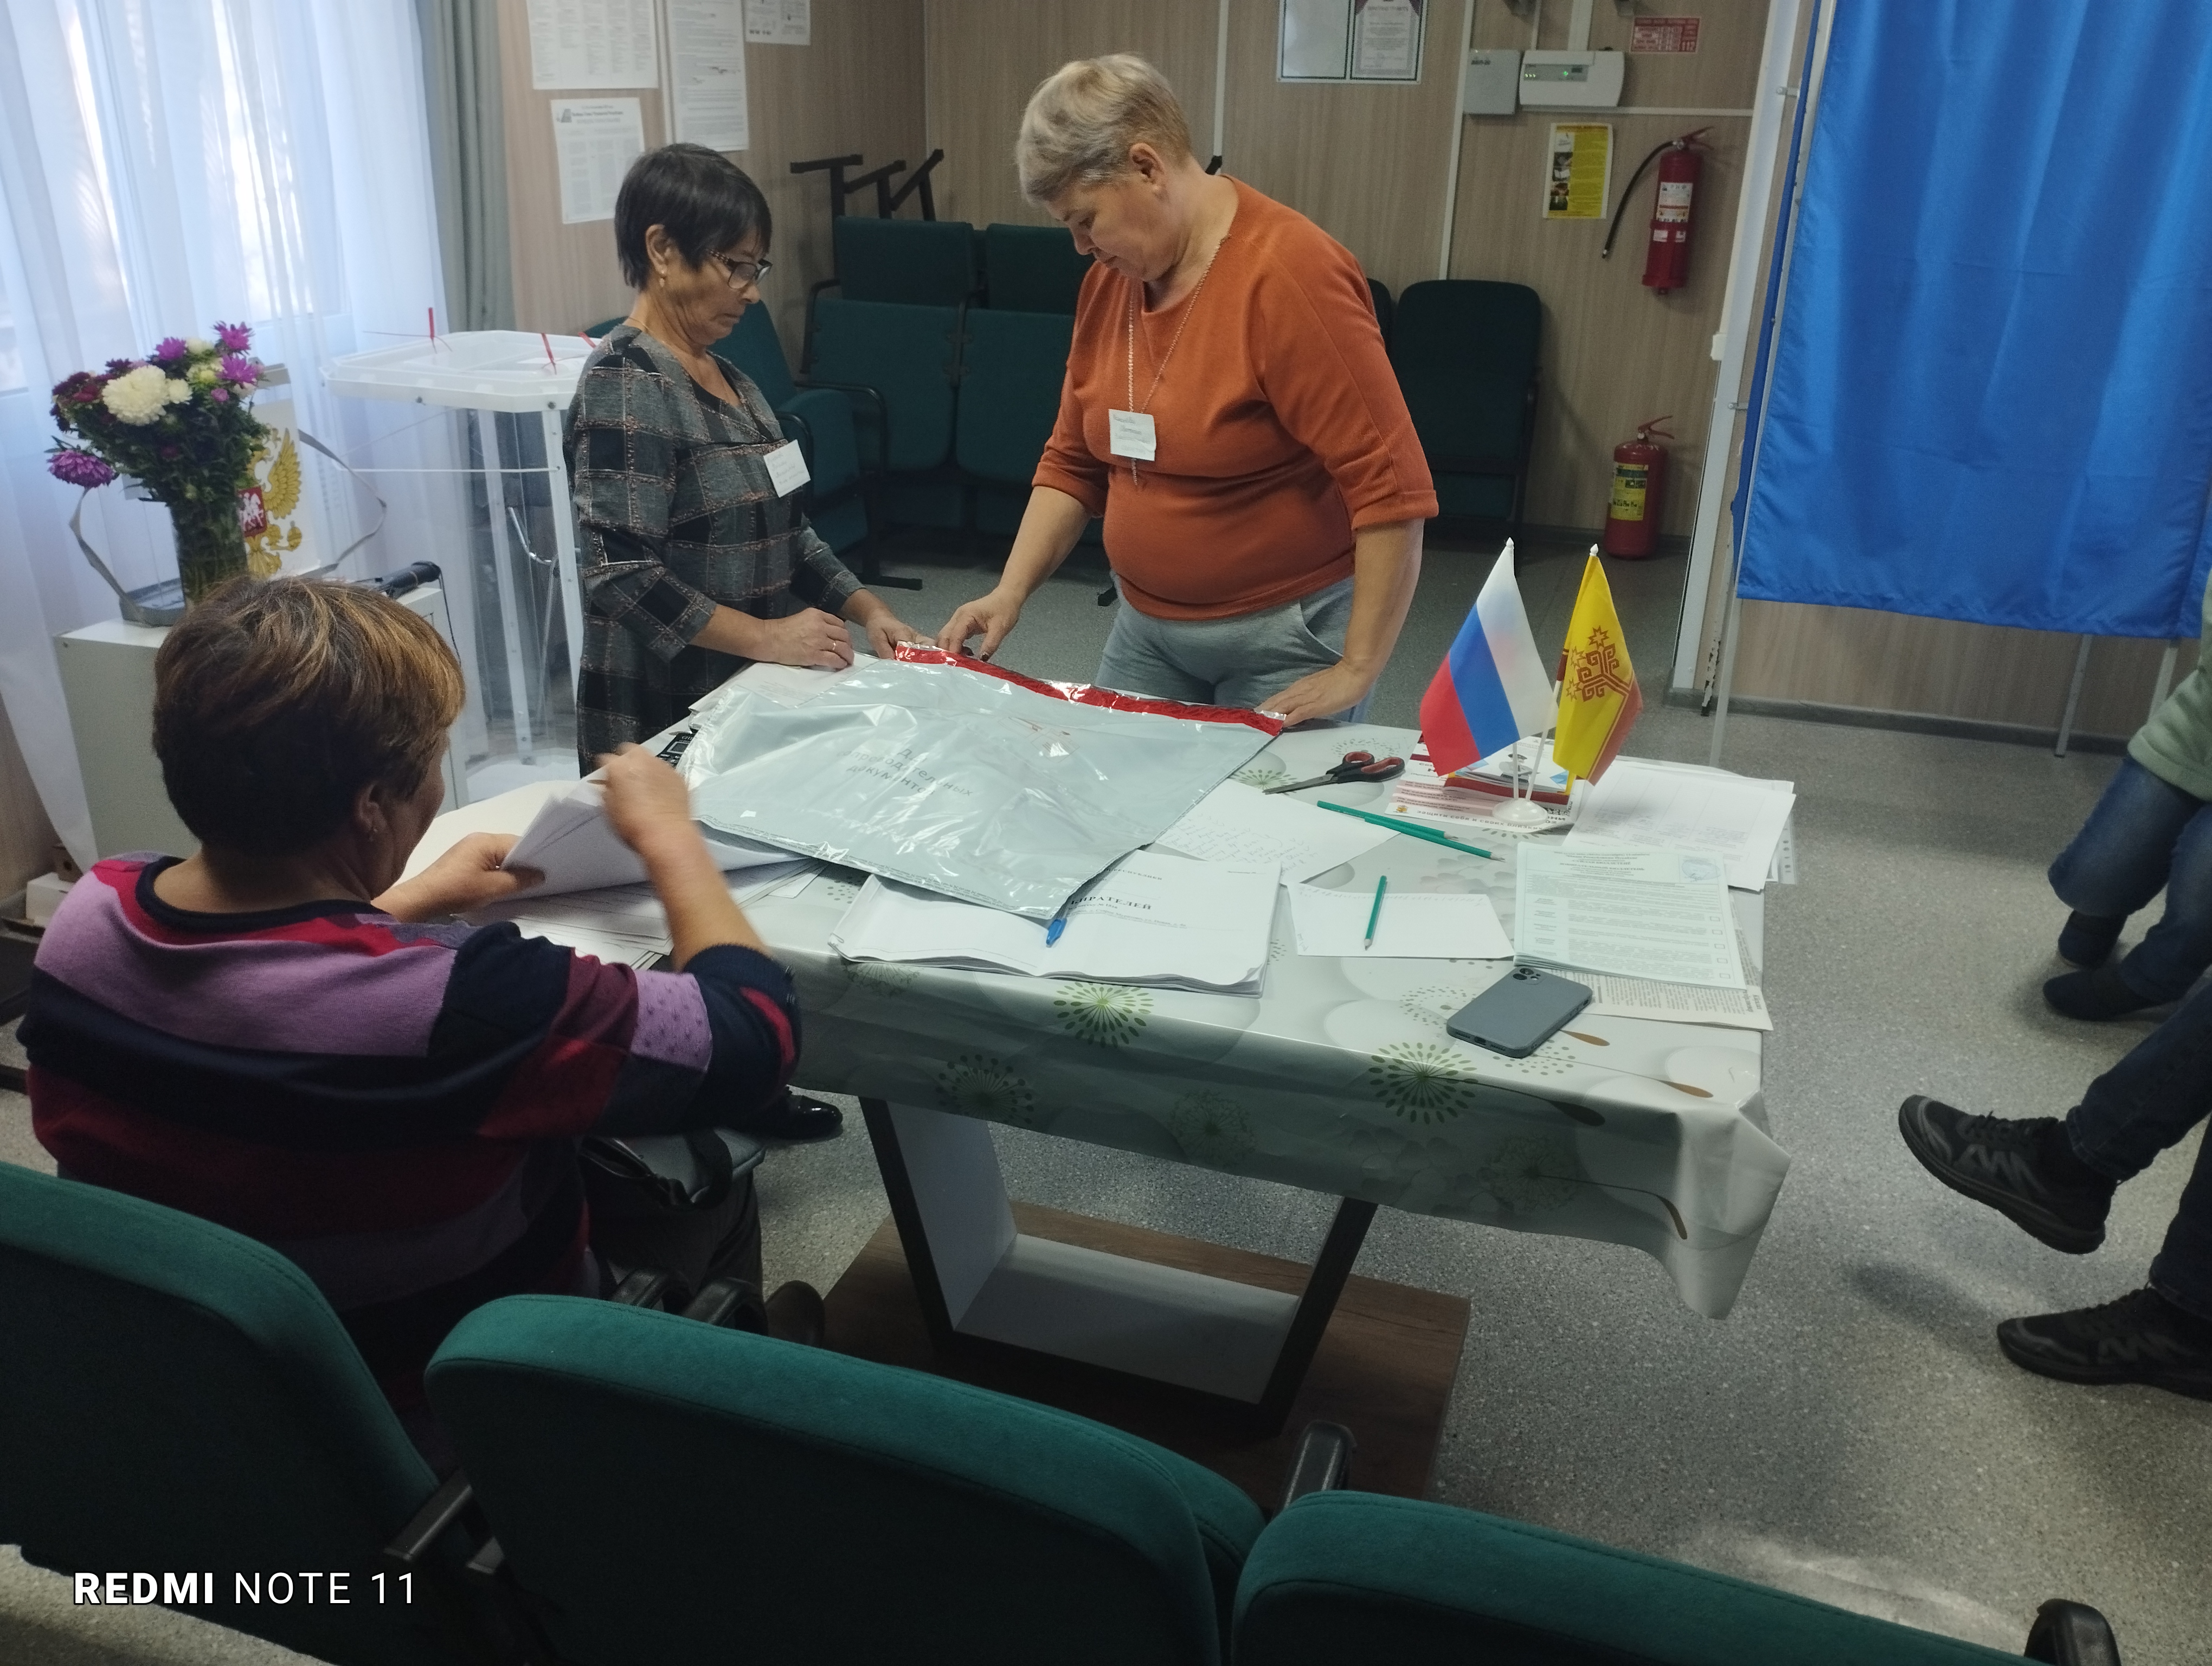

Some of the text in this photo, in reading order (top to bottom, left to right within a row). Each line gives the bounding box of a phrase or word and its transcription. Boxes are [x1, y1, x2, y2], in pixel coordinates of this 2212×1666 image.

[837, 750, 974, 797] сопроводтельных
[1416, 810, 1449, 818] защити
[1070, 896, 1152, 910] БИРАТЕЛЕЙ
